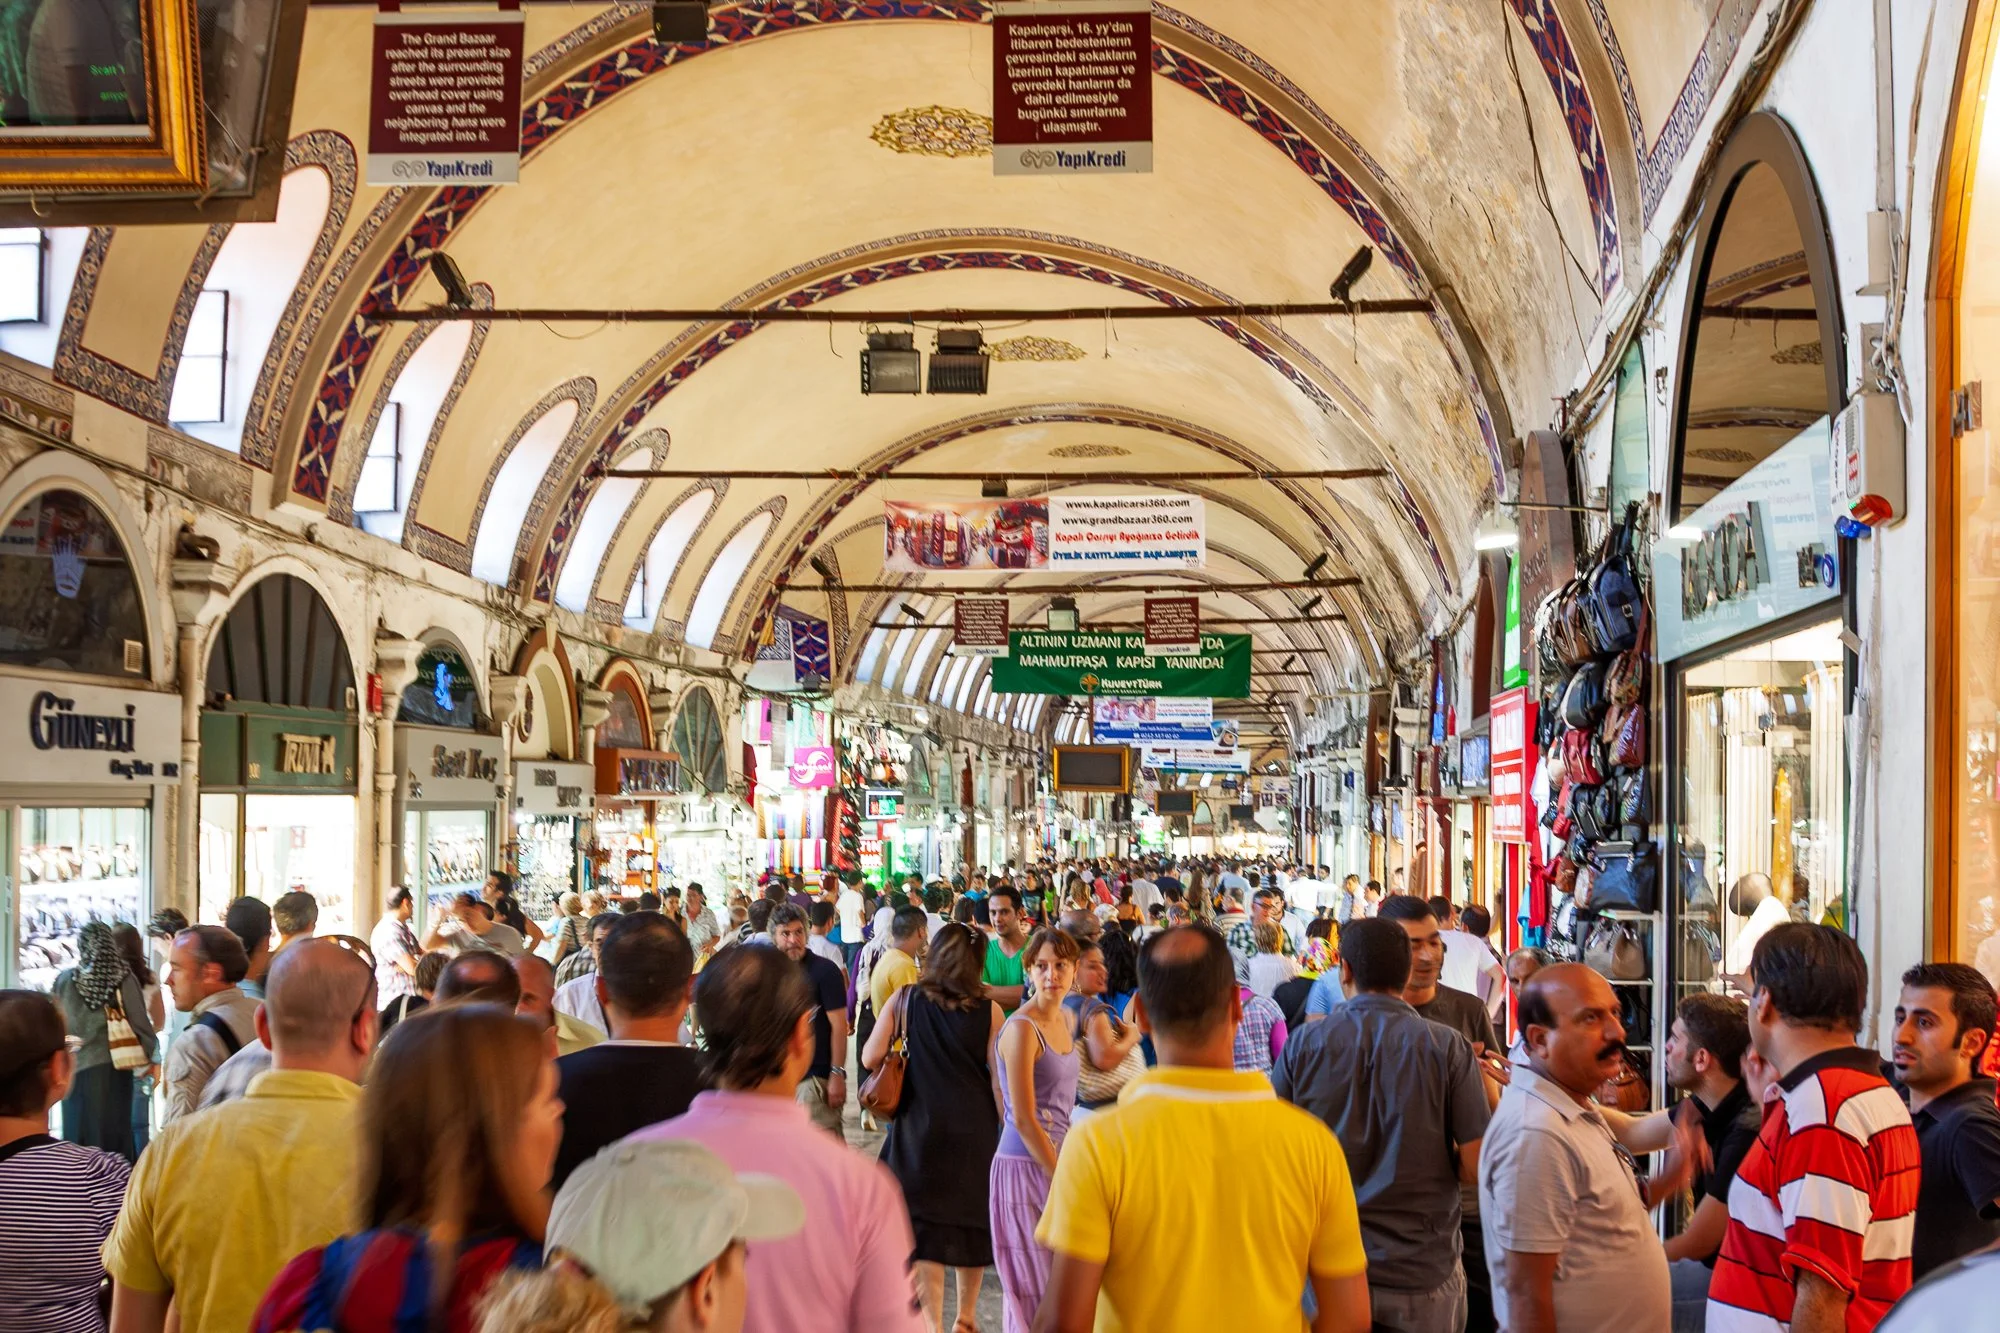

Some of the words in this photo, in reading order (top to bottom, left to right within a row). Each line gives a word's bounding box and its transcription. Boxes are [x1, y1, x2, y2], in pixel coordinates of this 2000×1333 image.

[1077, 23, 1093, 35] 16.
[1096, 21, 1133, 35] yy'dan
[401, 32, 422, 44] The
[423, 32, 457, 44] Grand
[459, 32, 497, 44] Bazaar
[1011, 38, 1052, 50] itibaren
[1056, 36, 1131, 48] bedestenlerin
[385, 47, 428, 60] reached
[430, 48, 444, 58] its
[446, 47, 487, 61] present
[489, 47, 511, 58] size
[1006, 52, 1076, 64] çevresindeki
[1079, 50, 1137, 61] sokakların
[391, 61, 416, 73] after
[419, 61, 435, 72] the
[438, 60, 503, 74] surrounding
[1008, 66, 1052, 78] üzerinin
[1056, 64, 1118, 80] kapatılması
[1122, 65, 1135, 74] ve
[389, 75, 426, 87] streets
[429, 76, 454, 86] were
[457, 73, 504, 88] provided
[1012, 79, 1066, 94] çevredeki
[1069, 78, 1114, 89] hanların
[1118, 77, 1131, 88] da
[389, 89, 439, 101] overhead
[441, 91, 471, 101] cover
[473, 88, 503, 102] using
[1025, 93, 1052, 105] dahil
[1055, 92, 1118, 105] edilmesiyle
[405, 104, 443, 114] canvas
[446, 102, 466, 114] and
[468, 102, 486, 113] the
[1018, 107, 1067, 122] bugünkü
[1070, 106, 1126, 118] sınırlarına
[384, 117, 449, 130] neighboring
[451, 117, 478, 128] hans
[480, 118, 506, 127] were
[1043, 121, 1102, 134] ulaşmıştır.
[400, 131, 453, 144] integrated
[455, 131, 476, 142] into
[479, 130, 489, 141] it.
[1056, 150, 1126, 169] YapıKredi
[427, 160, 493, 178] YapıKredi
[1061, 514, 1193, 527] www.grandbazaar360.com
[1019, 635, 1068, 649] ALTININ
[1071, 636, 1121, 650] UZMANI
[1019, 654, 1108, 671] MAHMUTPAŞA
[1164, 656, 1225, 670] YANINDA!
